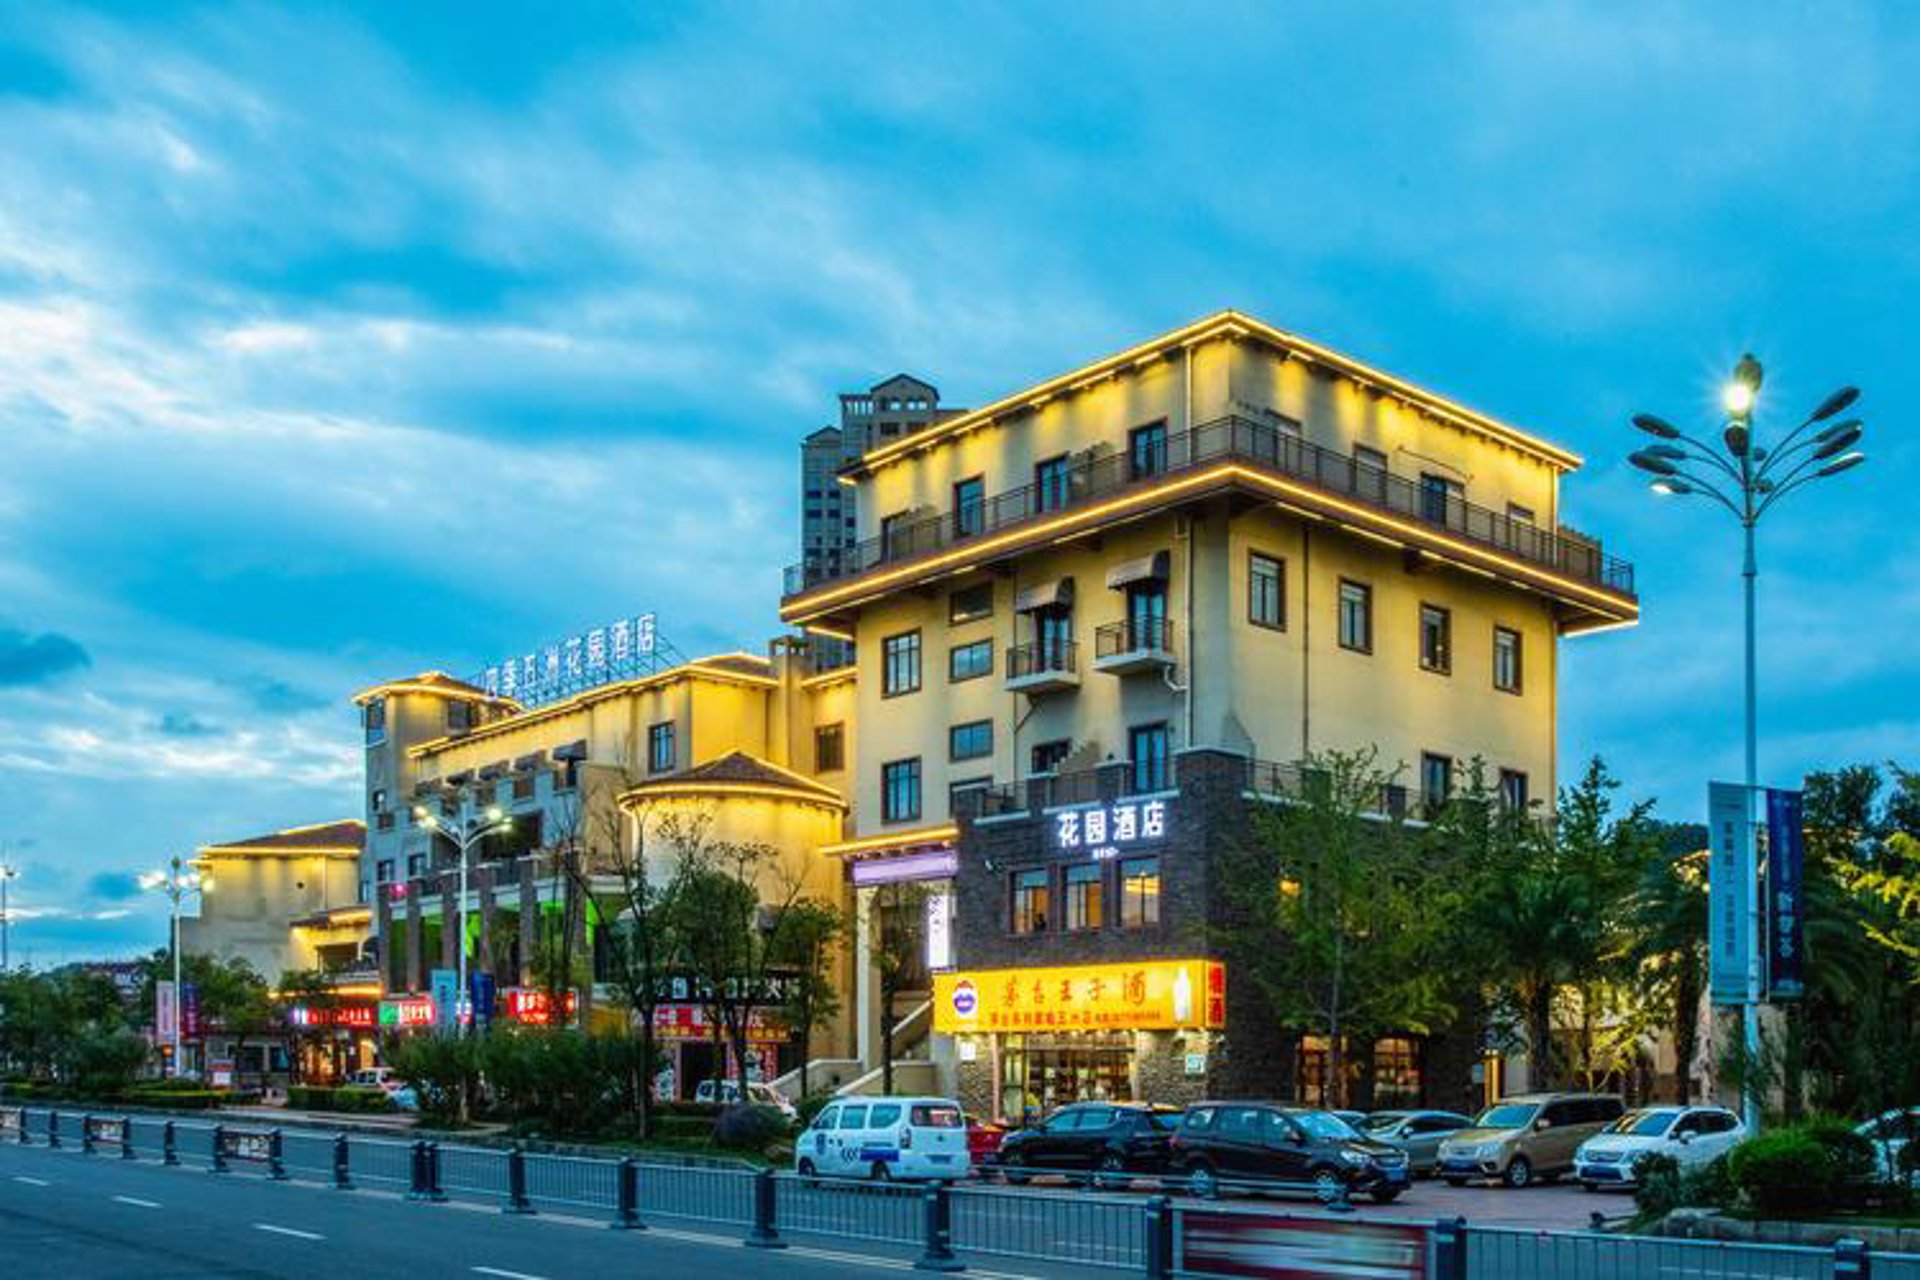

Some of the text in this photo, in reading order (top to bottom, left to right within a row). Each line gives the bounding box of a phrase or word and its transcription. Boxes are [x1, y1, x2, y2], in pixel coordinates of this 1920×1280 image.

[485, 612, 656, 699] 花园酒店
[1056, 800, 1166, 848] 花园酒店
[1000, 969, 1148, 1008] 茅台王子酒
